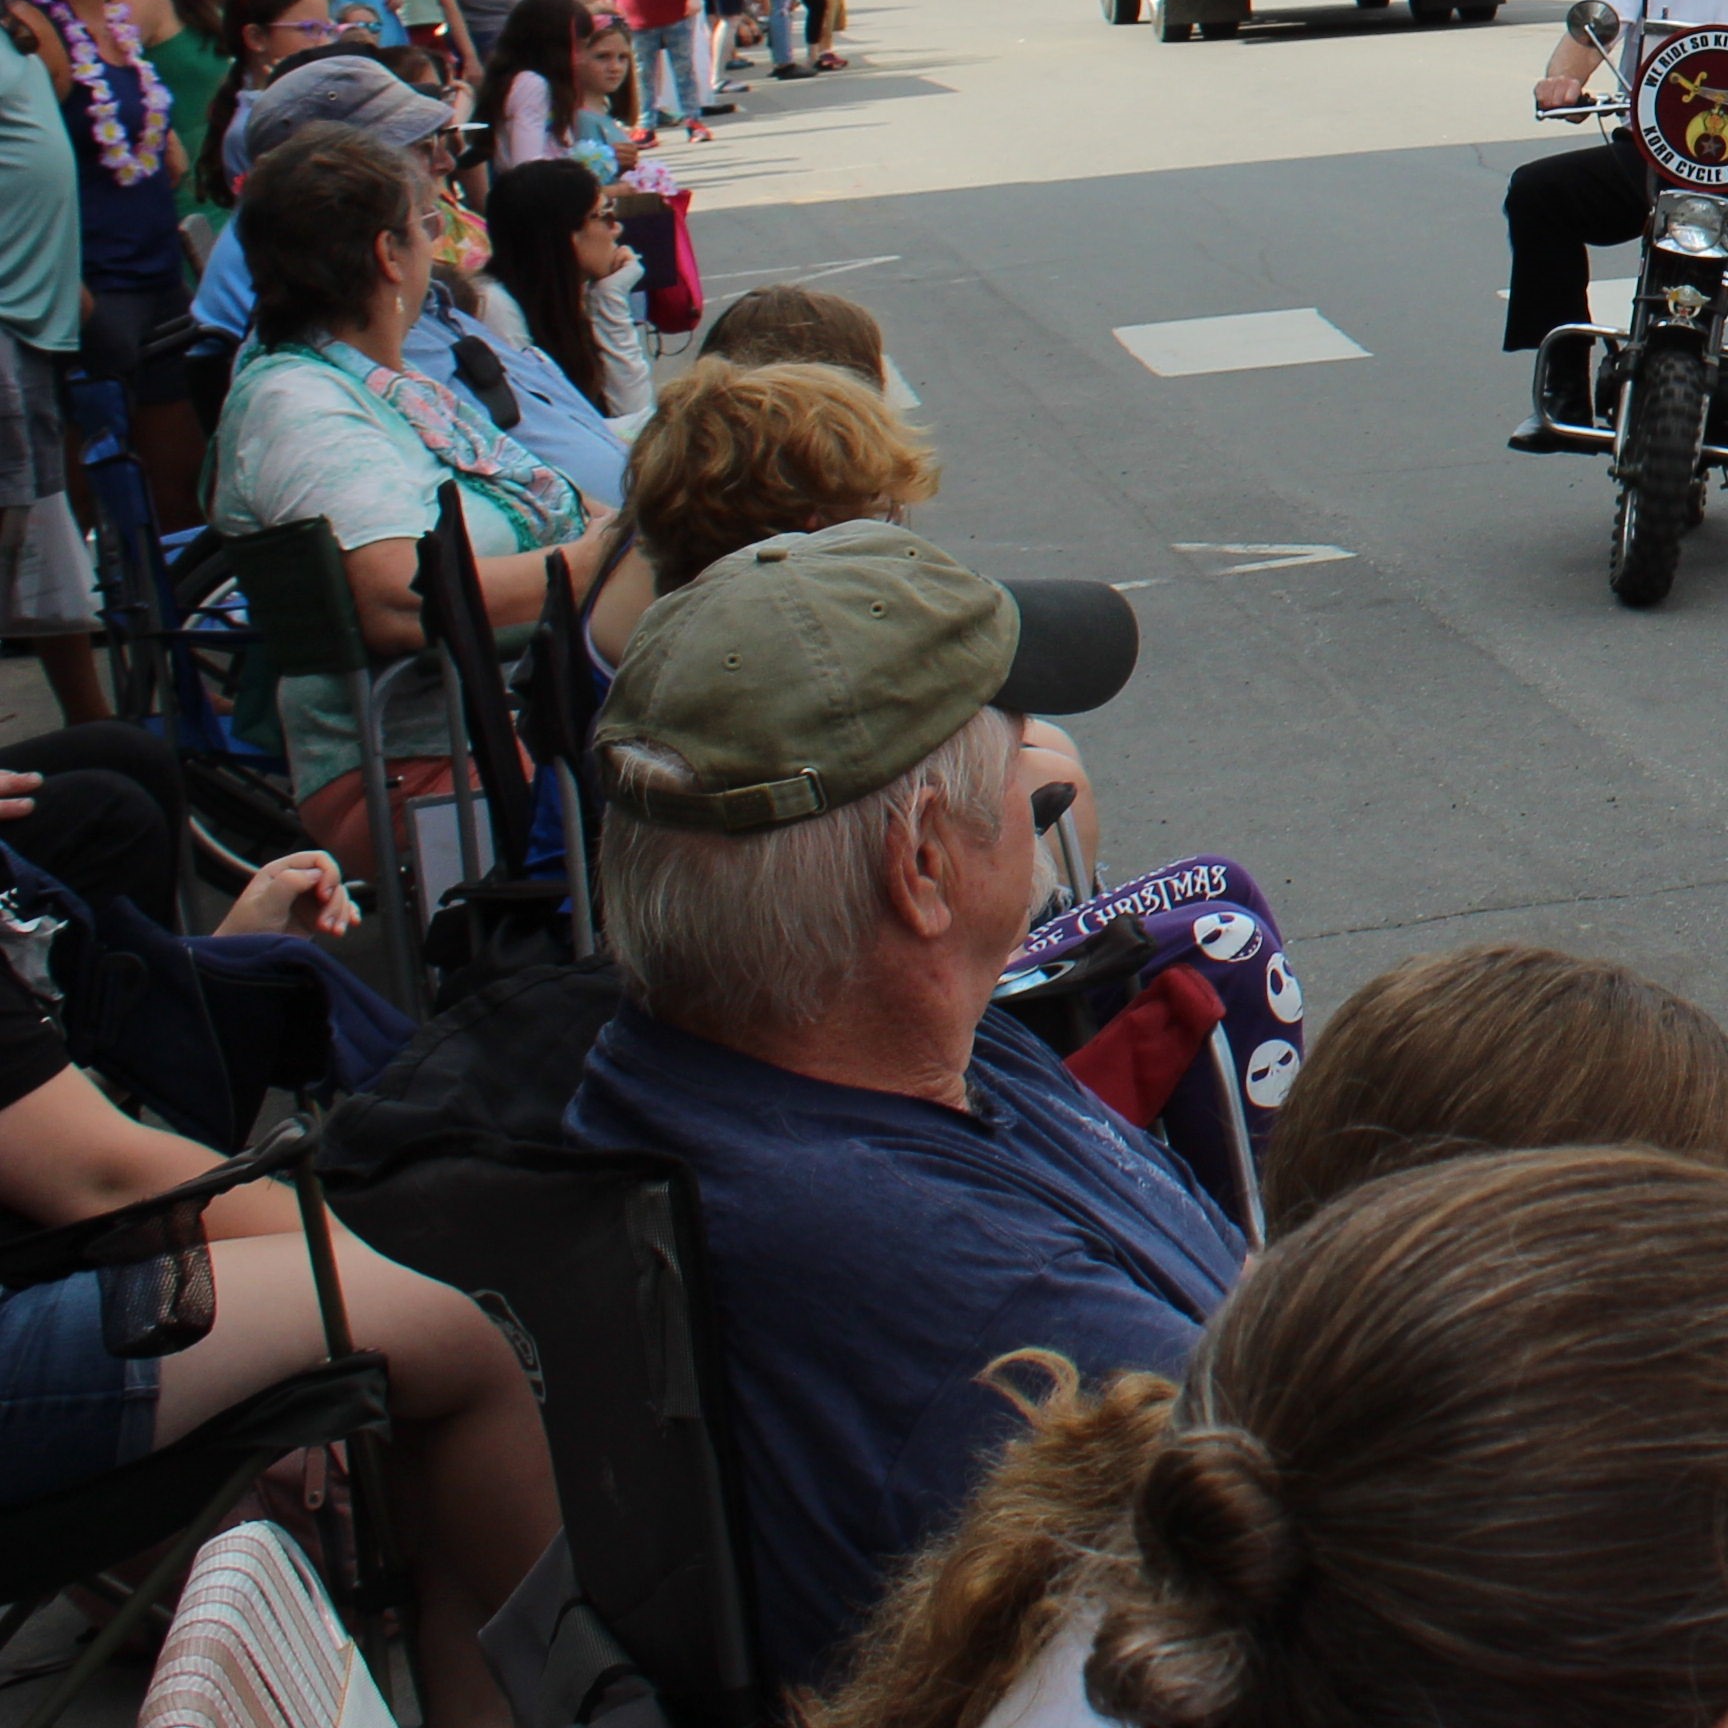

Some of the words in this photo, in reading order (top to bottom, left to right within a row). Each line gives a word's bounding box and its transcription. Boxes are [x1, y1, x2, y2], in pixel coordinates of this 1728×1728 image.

[1644, 67, 1664, 89] WE
[1657, 42, 1688, 68] RIDE
[1689, 33, 1710, 50] SO
[1642, 124, 1675, 166] KORA
[1674, 159, 1724, 183] CYCLE
[1076, 864, 1228, 936] CHRISTMAS
